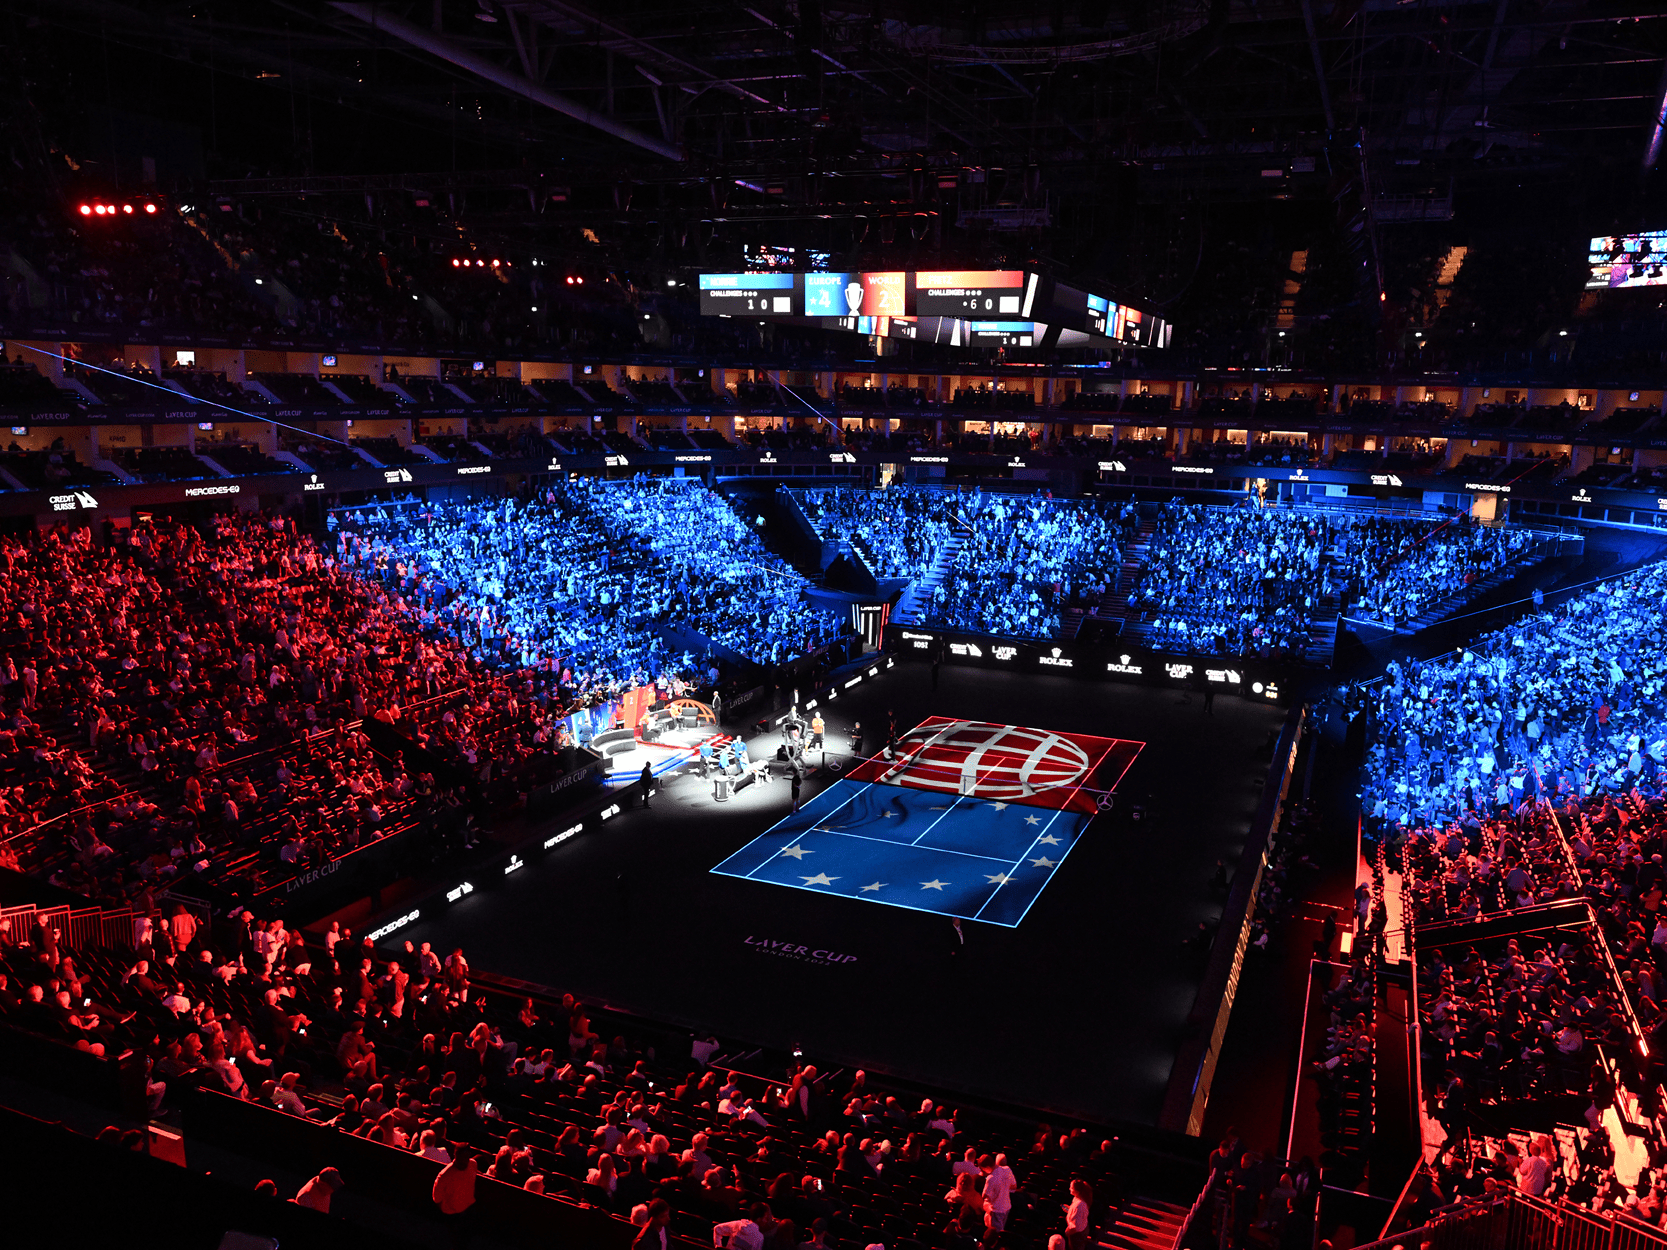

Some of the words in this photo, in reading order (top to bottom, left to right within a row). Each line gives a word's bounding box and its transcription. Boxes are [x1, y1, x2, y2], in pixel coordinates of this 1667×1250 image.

[808, 277, 842, 285] EUROPE
[868, 276, 900, 285] WORLD
[819, 290, 831, 308] 4
[878, 290, 890, 308] 2
[748, 300, 754, 310] 1
[760, 300, 768, 310] 0
[970, 299, 977, 310] 6
[985, 299, 993, 310] 0
[458, 466, 491, 474] MERCEDES-EQ
[186, 486, 240, 496] MERCEDES-EQ
[1466, 483, 1511, 492] MERCEDES-EQ
[49, 495, 75, 503] CREDIT
[54, 502, 76, 511] SUISSE
[992, 646, 1017, 656] LAVER
[996, 652, 1011, 660] CUP
[1040, 657, 1073, 667] ROLEX
[1107, 664, 1142, 674] ROLEX
[1166, 663, 1193, 674] LAVER
[744, 692, 753, 702] CUP
[551, 776, 572, 793] LAVER
[573, 769, 587, 782] CUP
[286, 870, 320, 893] LAVER
[321, 860, 342, 876] CUP
[744, 936, 809, 955] LAVER
[812, 950, 858, 964] CUP
[756, 947, 800, 960] LONDON
